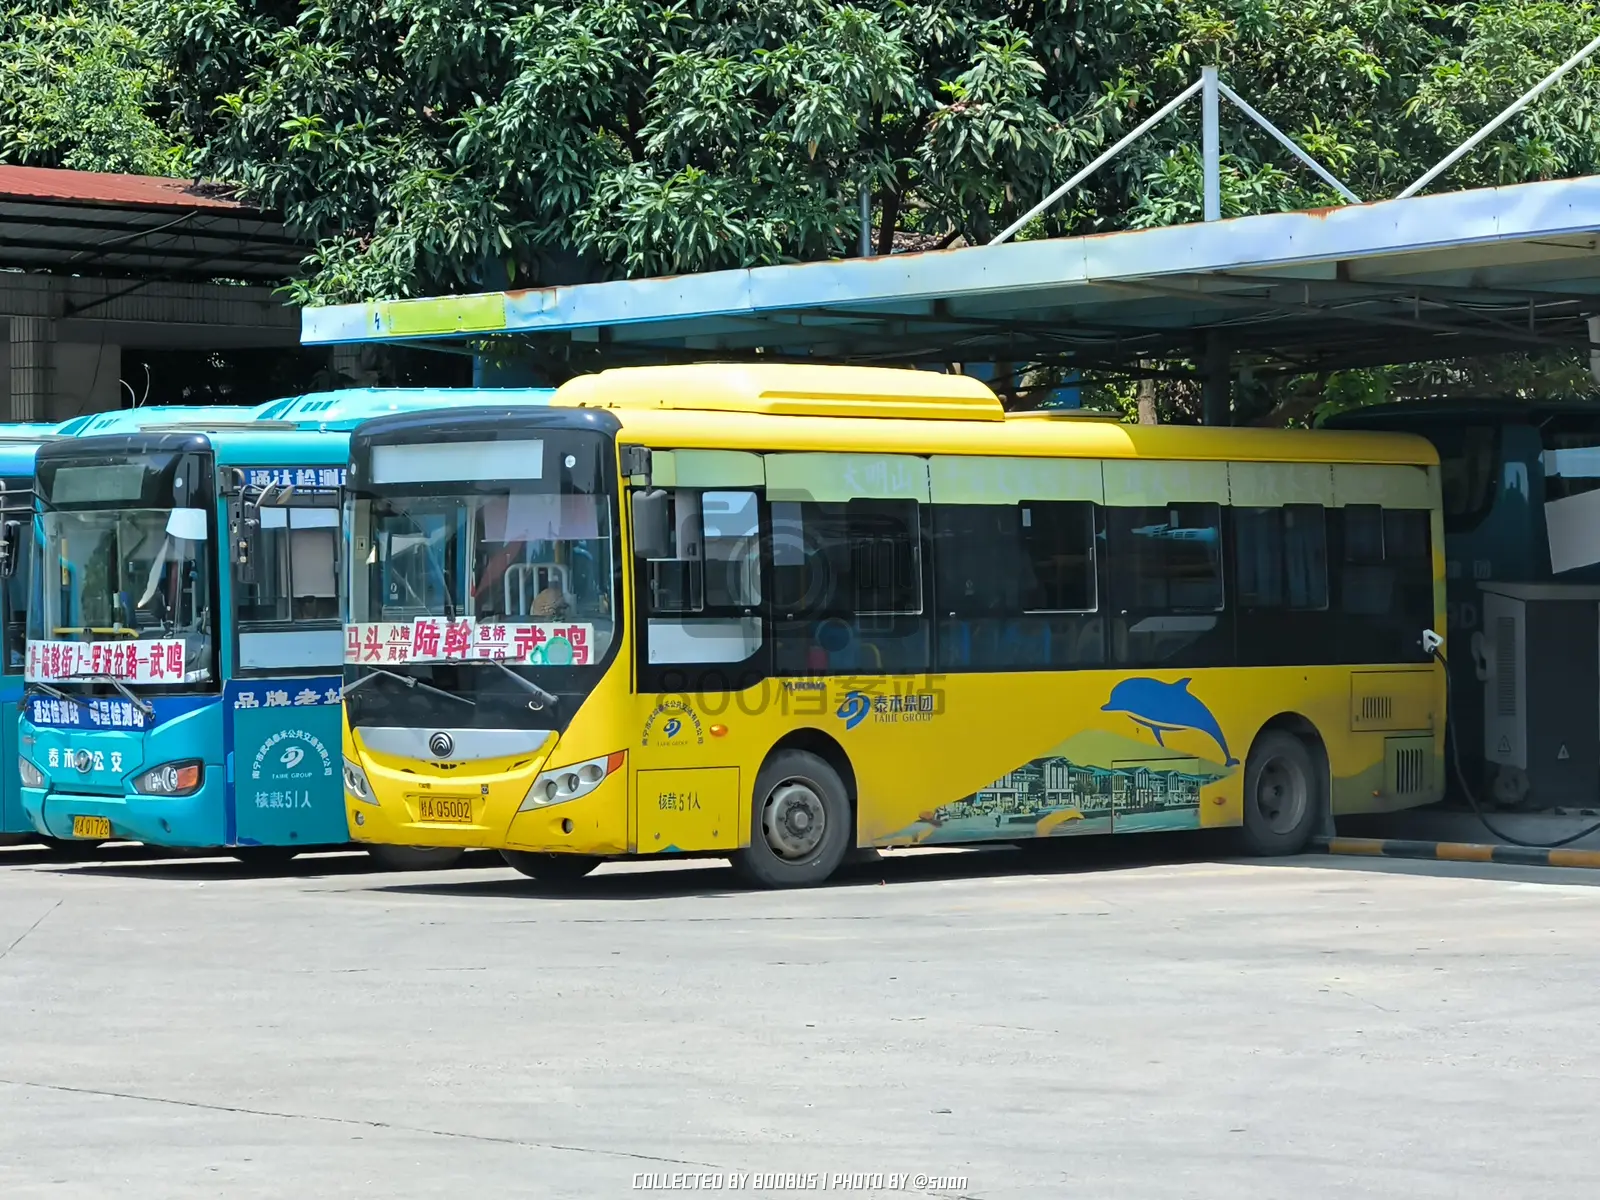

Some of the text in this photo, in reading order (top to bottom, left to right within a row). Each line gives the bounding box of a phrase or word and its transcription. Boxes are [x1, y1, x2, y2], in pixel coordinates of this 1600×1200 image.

[390, 625, 411, 641] 小陆
[412, 619, 472, 659] 陆斡
[345, 625, 384, 662] 马头
[874, 694, 934, 713] 泰禾集团
[254, 789, 312, 808] 核载51人
[658, 791, 701, 811] 核载51人
